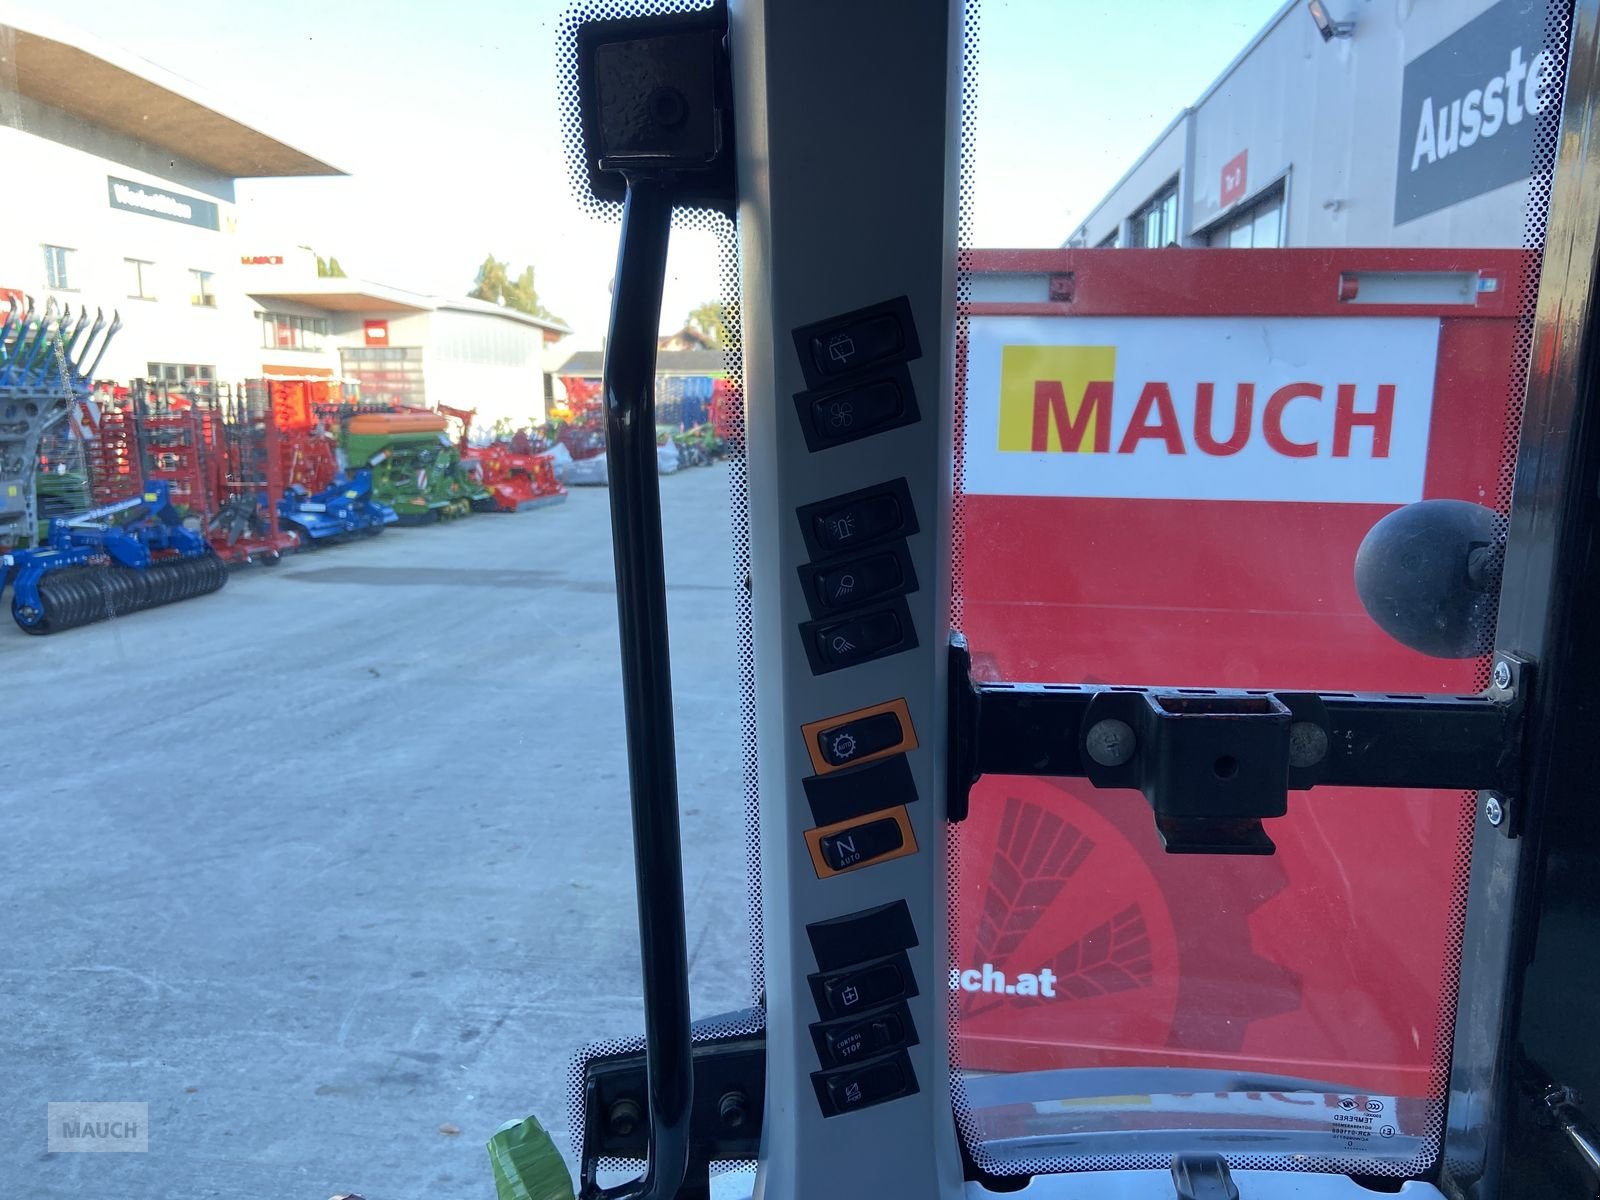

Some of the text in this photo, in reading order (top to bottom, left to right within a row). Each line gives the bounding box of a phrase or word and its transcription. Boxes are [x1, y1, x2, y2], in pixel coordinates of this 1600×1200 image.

[1031, 380, 1396, 459] MAUCH
[838, 740, 852, 751] AUTO
[836, 835, 855, 858] N
[840, 852, 861, 867] AUTO
[837, 1033, 862, 1049] CONTROL
[842, 1042, 861, 1057] STOP
